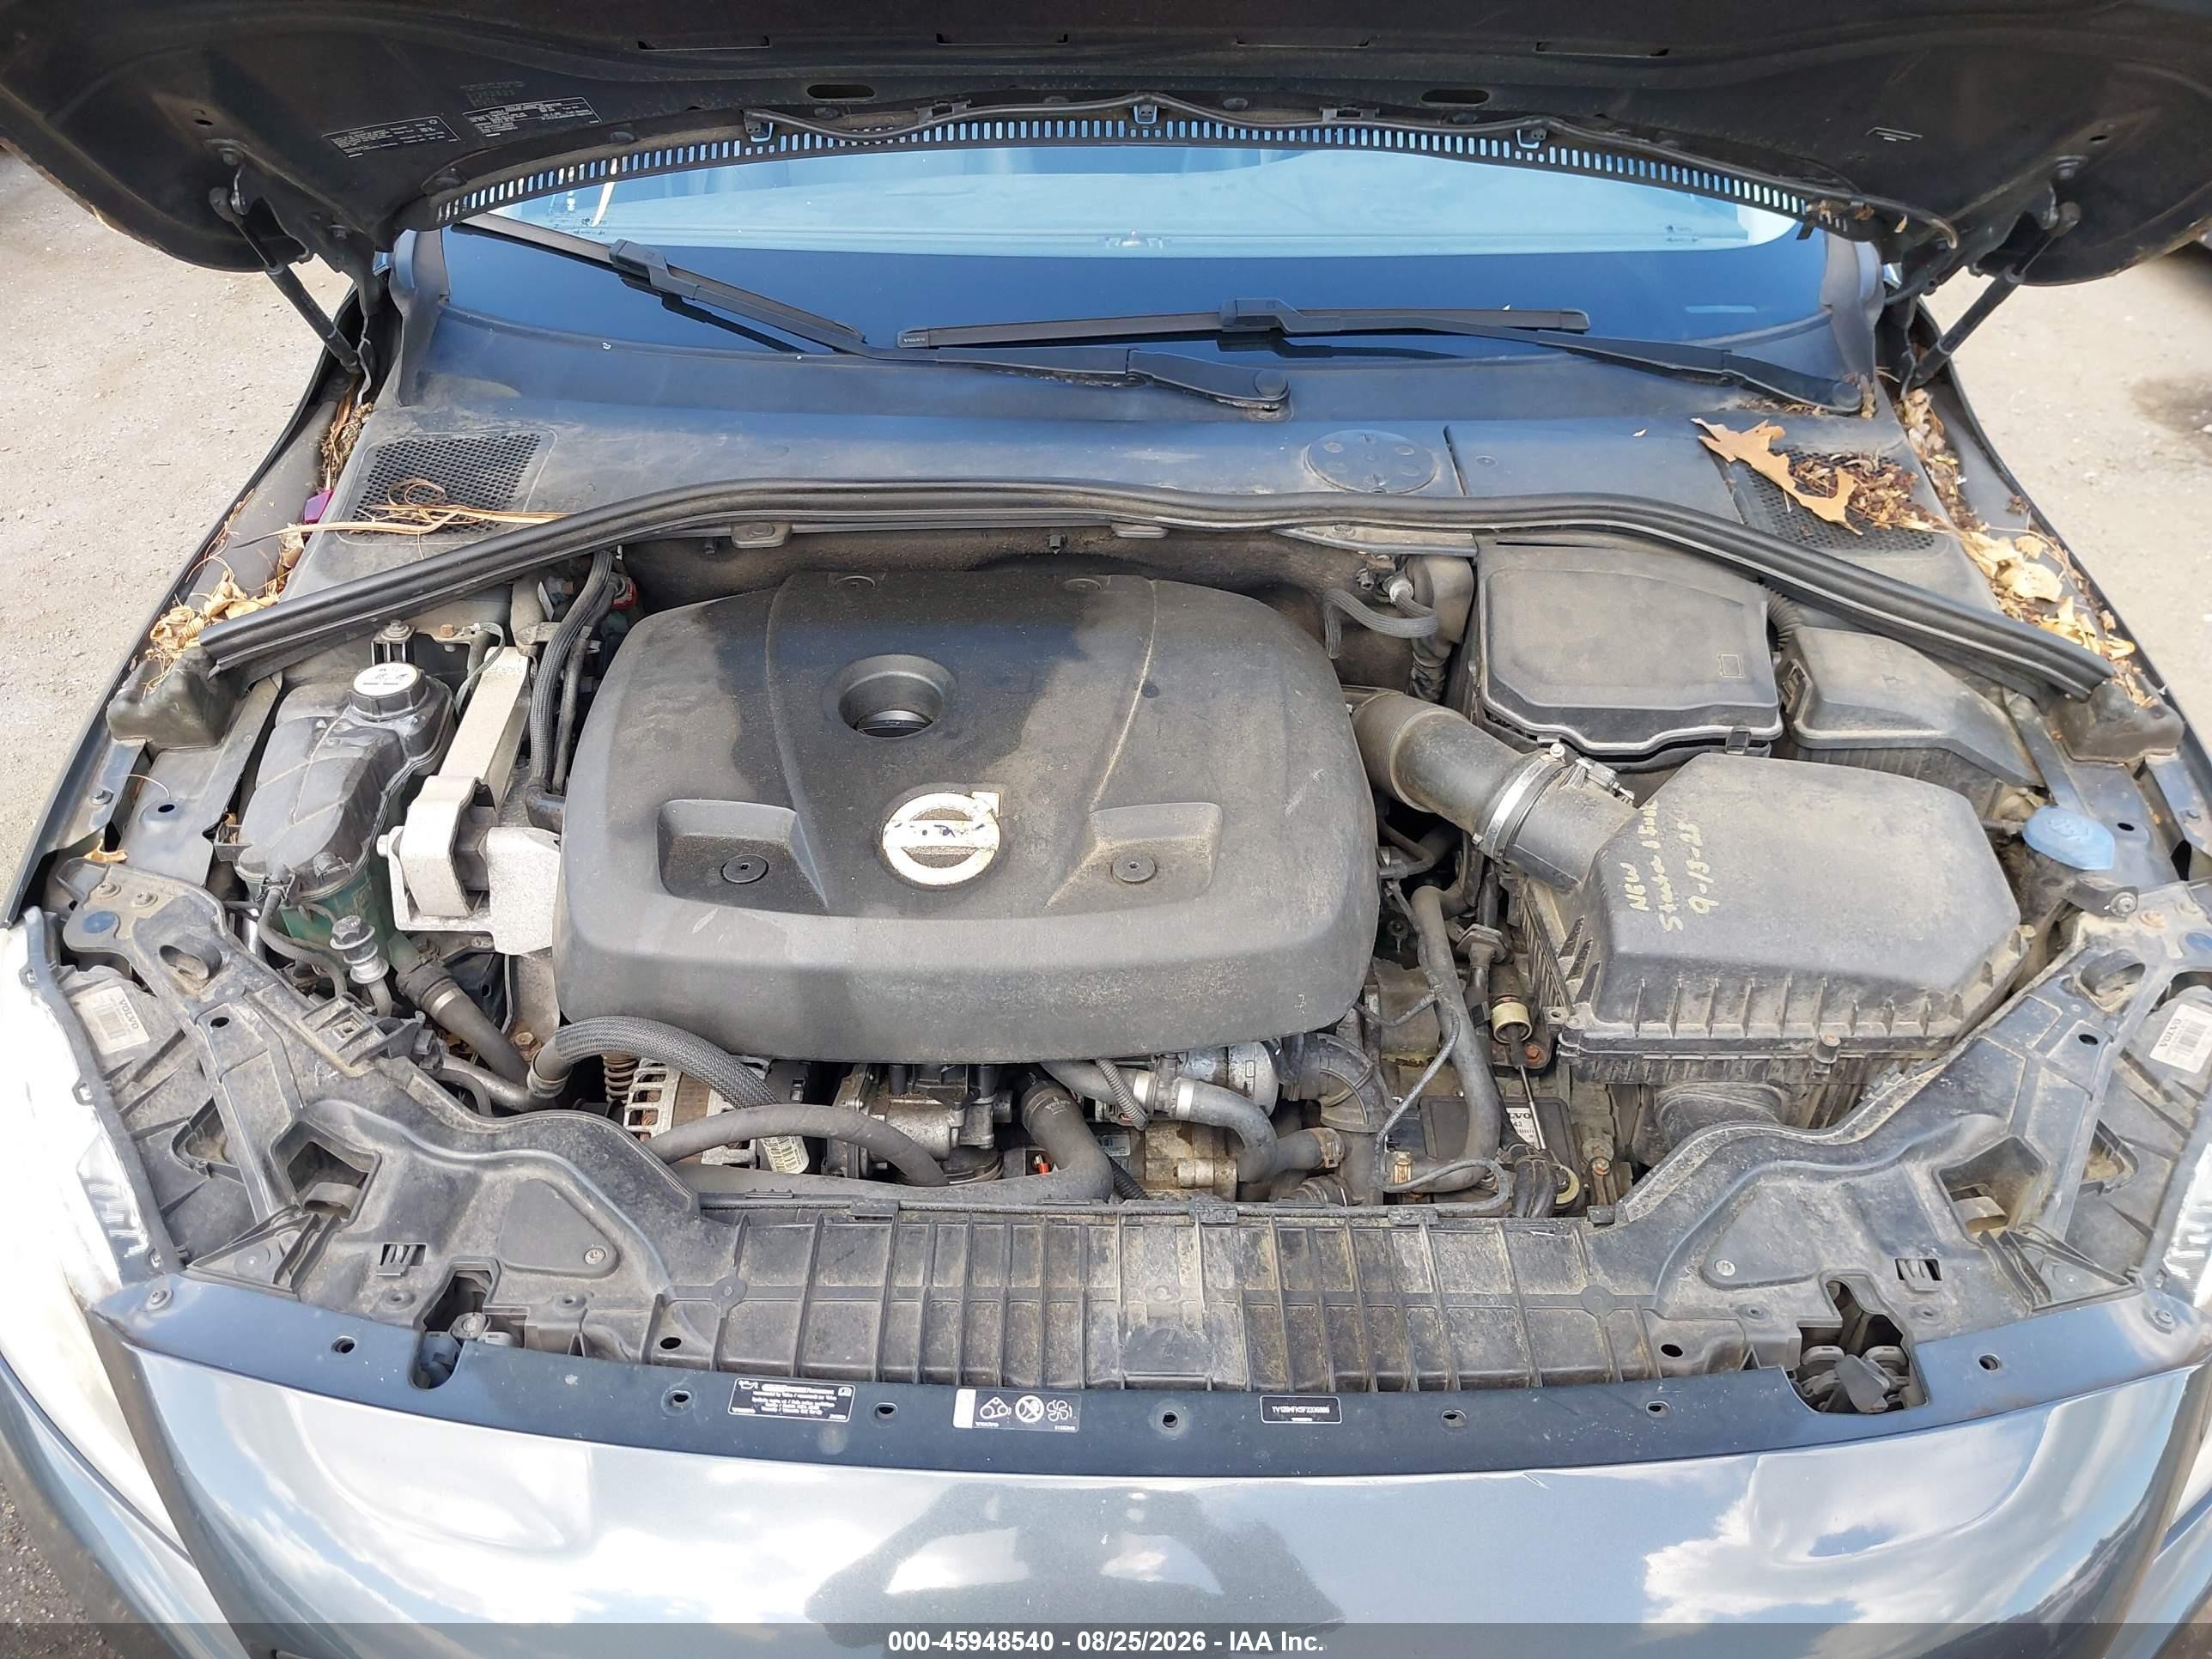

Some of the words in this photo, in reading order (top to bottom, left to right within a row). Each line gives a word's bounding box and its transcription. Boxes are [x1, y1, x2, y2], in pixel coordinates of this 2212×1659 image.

[1620, 862, 1650, 911] NEW
[118, 996, 140, 1030] VOLVO
[2159, 1018, 2182, 1048] VOLVO
